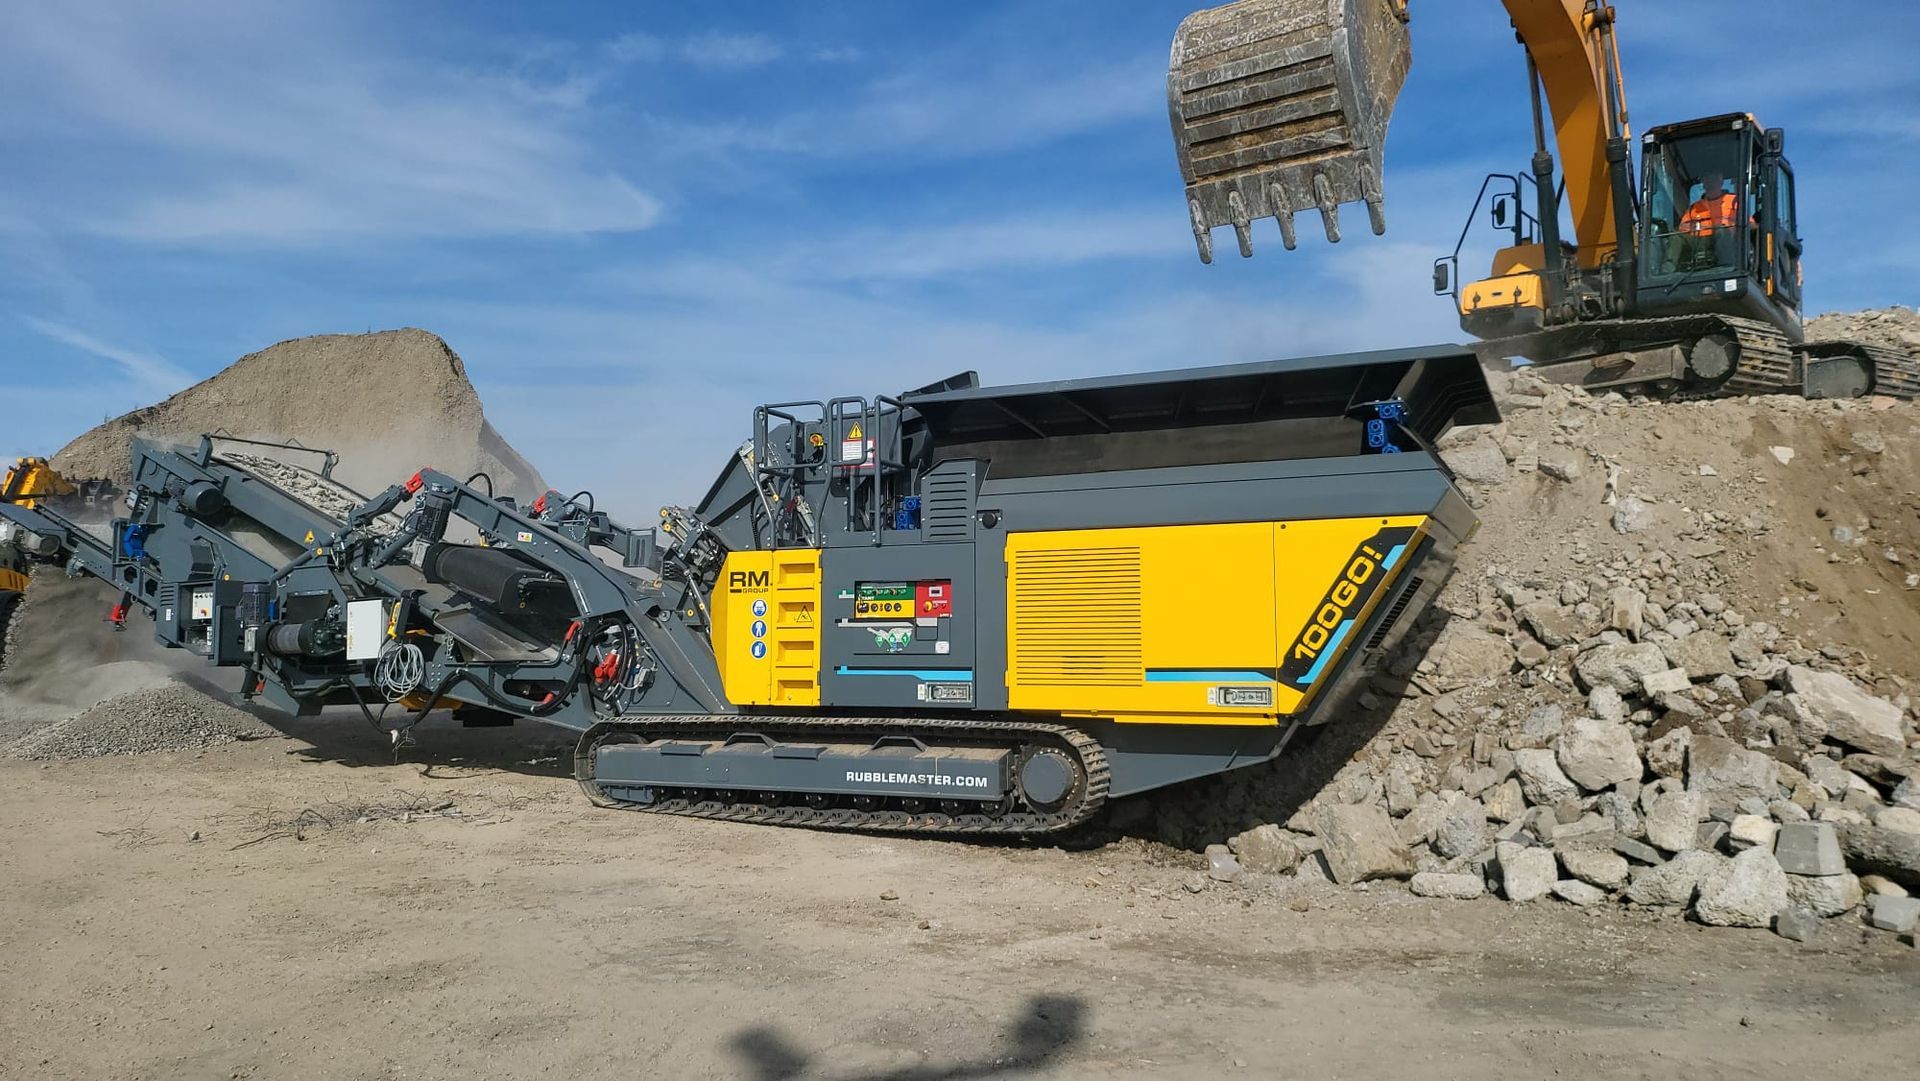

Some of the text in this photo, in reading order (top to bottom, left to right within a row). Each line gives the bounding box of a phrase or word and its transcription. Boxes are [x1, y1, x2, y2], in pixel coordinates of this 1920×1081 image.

[730, 570, 770, 587] RM
[1294, 545, 1383, 659] 100GO!
[846, 771, 988, 788] RUBBLEMASTER.COM
